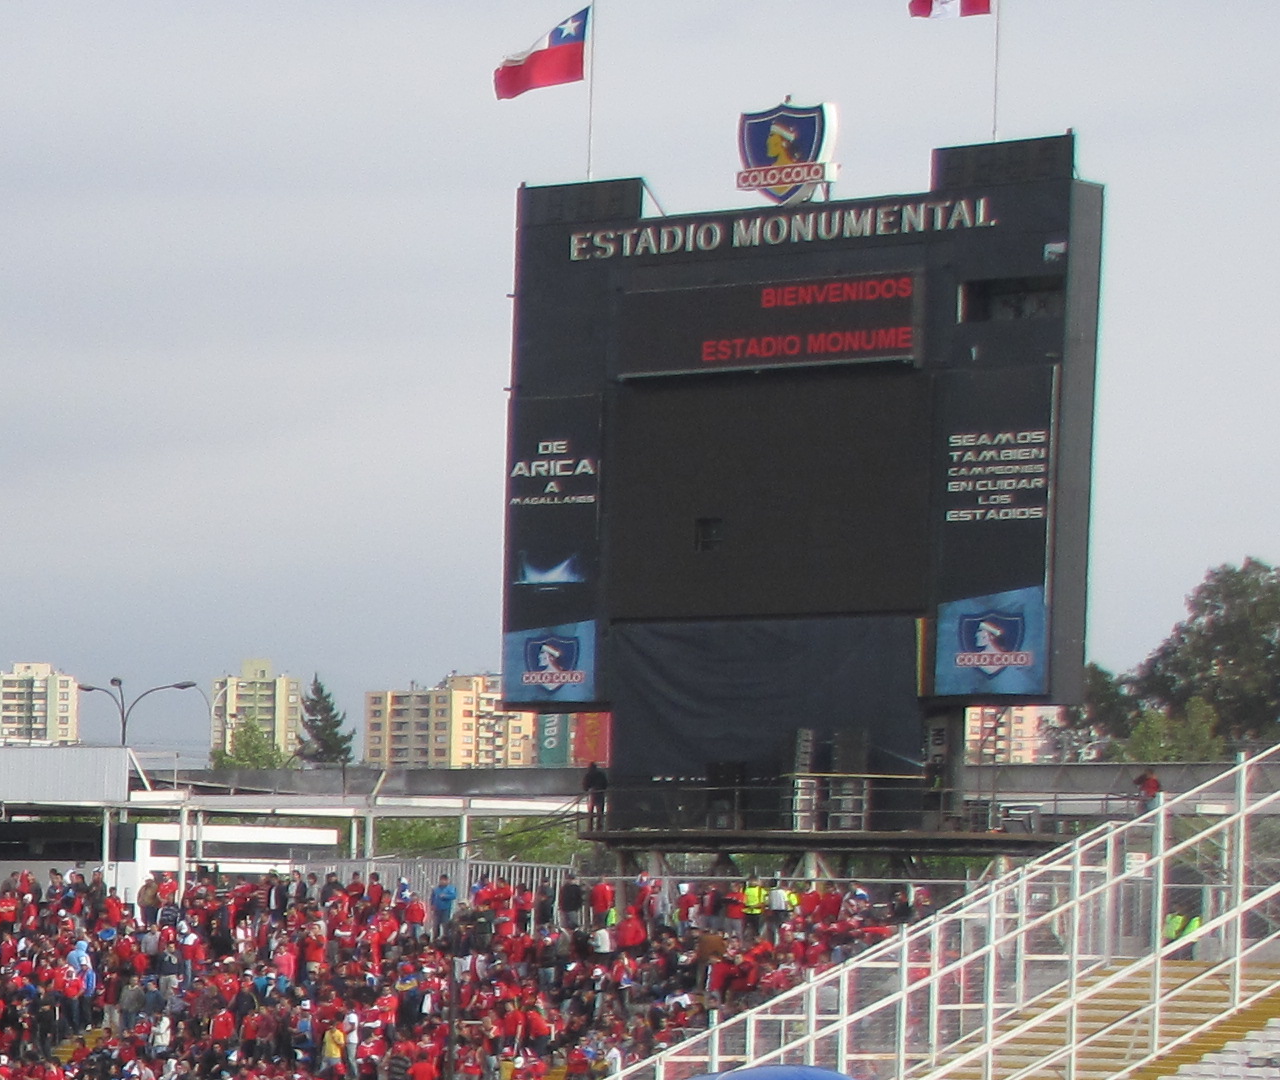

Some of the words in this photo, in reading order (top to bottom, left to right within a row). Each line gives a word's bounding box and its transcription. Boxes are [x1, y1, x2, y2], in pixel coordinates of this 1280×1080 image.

[569, 222, 720, 261] ESTADIO
[732, 198, 997, 247] MONUMENTAL
[761, 276, 913, 308] BIENVENIDOS
[701, 335, 801, 361] ESTADIO
[807, 327, 913, 354] MONUME
[948, 431, 1046, 447] SEAMOS
[538, 441, 568, 455] DE
[949, 448, 1046, 463] TAMBIEN
[510, 459, 595, 478] ARICA
[544, 481, 559, 494] A
[947, 481, 973, 493] EN
[975, 478, 1046, 492] CUIDAR
[977, 494, 1013, 506] LOS
[945, 507, 1044, 522] ESTADIOS
